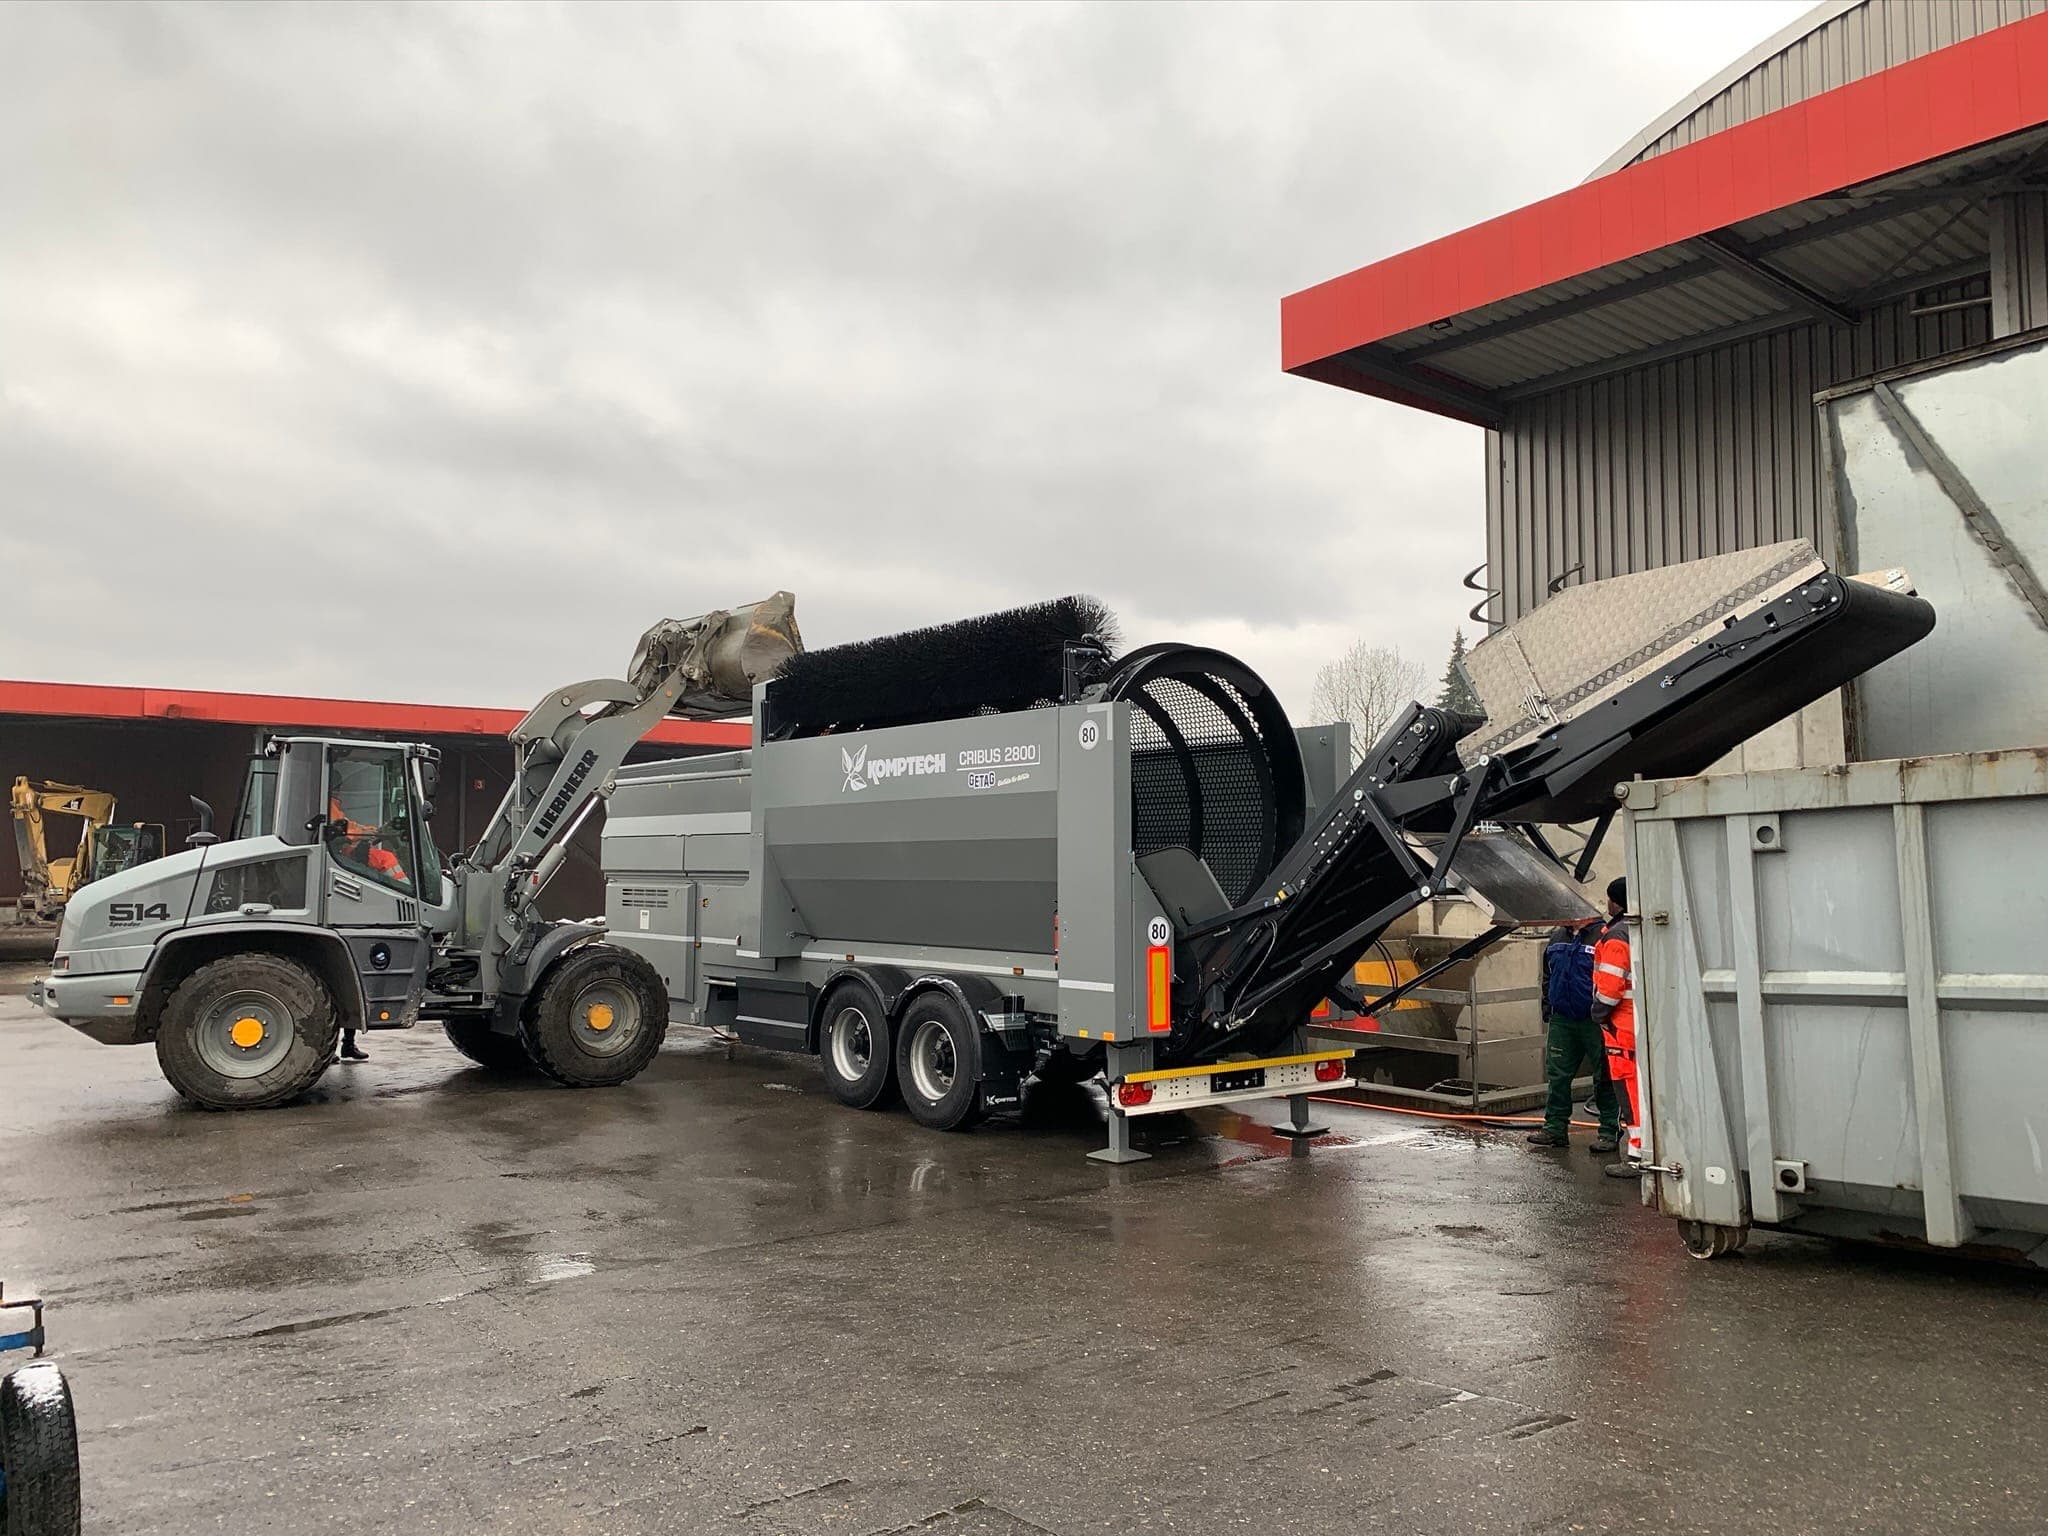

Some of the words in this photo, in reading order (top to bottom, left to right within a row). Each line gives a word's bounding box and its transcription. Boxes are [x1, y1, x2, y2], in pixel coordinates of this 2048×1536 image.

[1082, 727, 1095, 743] 80
[960, 748, 1000, 765] CRIBUS
[1004, 745, 1035, 762] 2800
[867, 753, 946, 785] KOMPTECH
[968, 771, 995, 789] GETAG
[533, 749, 599, 839] LIEBHERR
[109, 903, 170, 920] 514
[1152, 923, 1166, 939] 80
